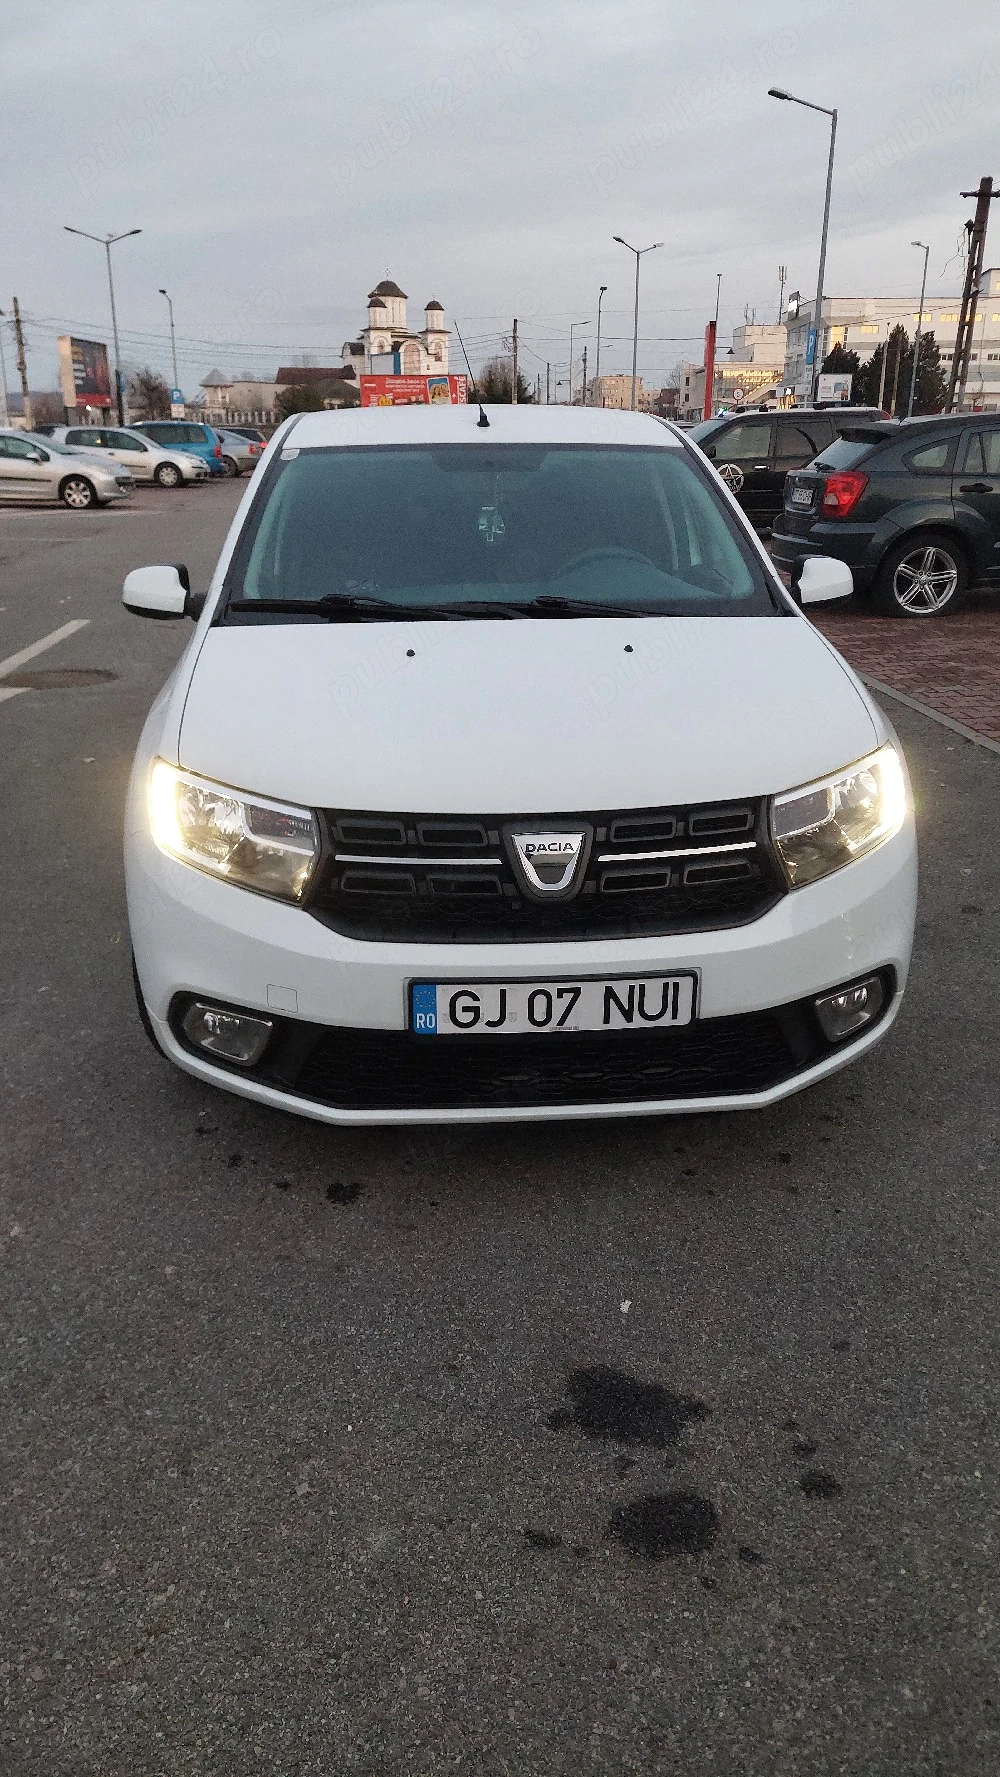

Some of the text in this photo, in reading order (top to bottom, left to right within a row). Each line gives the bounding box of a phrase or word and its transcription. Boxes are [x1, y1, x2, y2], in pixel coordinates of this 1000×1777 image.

[525, 841, 574, 854] DACIA
[449, 981, 680, 1029] GJ 07 NUI
[416, 1012, 436, 1029] RO
